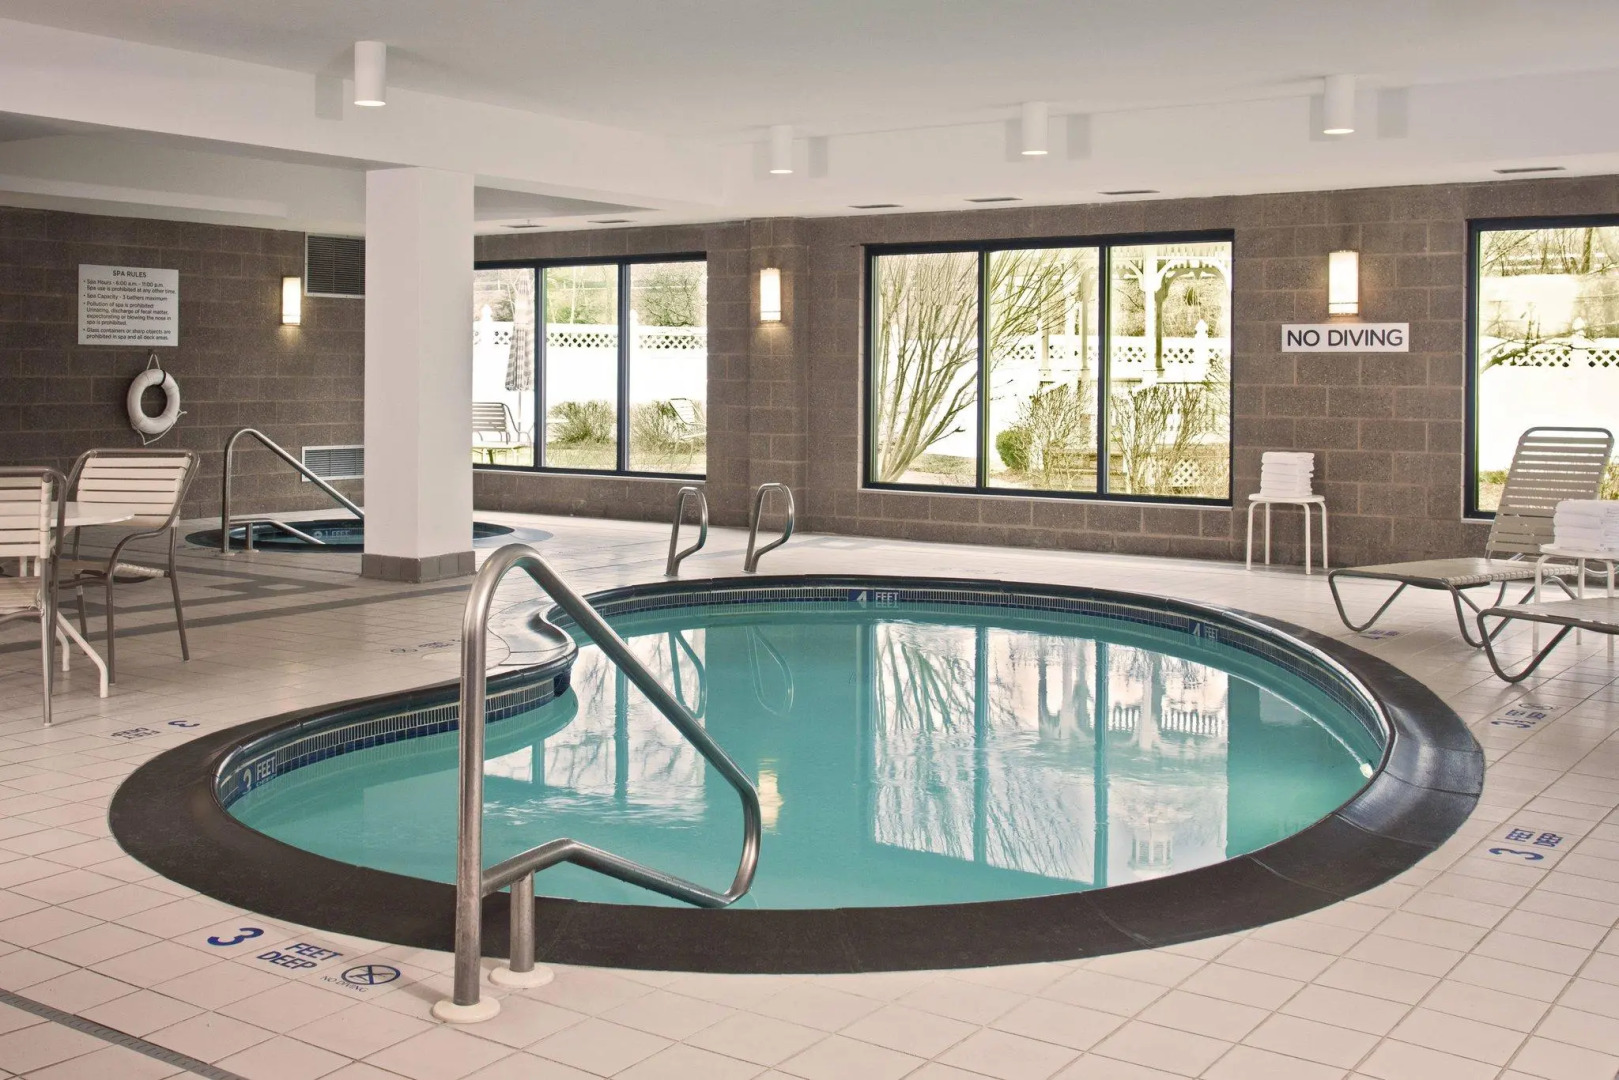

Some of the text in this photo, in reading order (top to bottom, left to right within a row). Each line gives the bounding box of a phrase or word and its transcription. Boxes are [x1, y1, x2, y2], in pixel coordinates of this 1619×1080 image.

[1287, 328, 1404, 347] NO DIVING
[876, 592, 898, 601] FEET
[242, 768, 252, 795] 3
[256, 756, 276, 781] FEET
[207, 927, 265, 946] 3
[256, 950, 318, 970] DEEP
[284, 942, 344, 961] FEET
